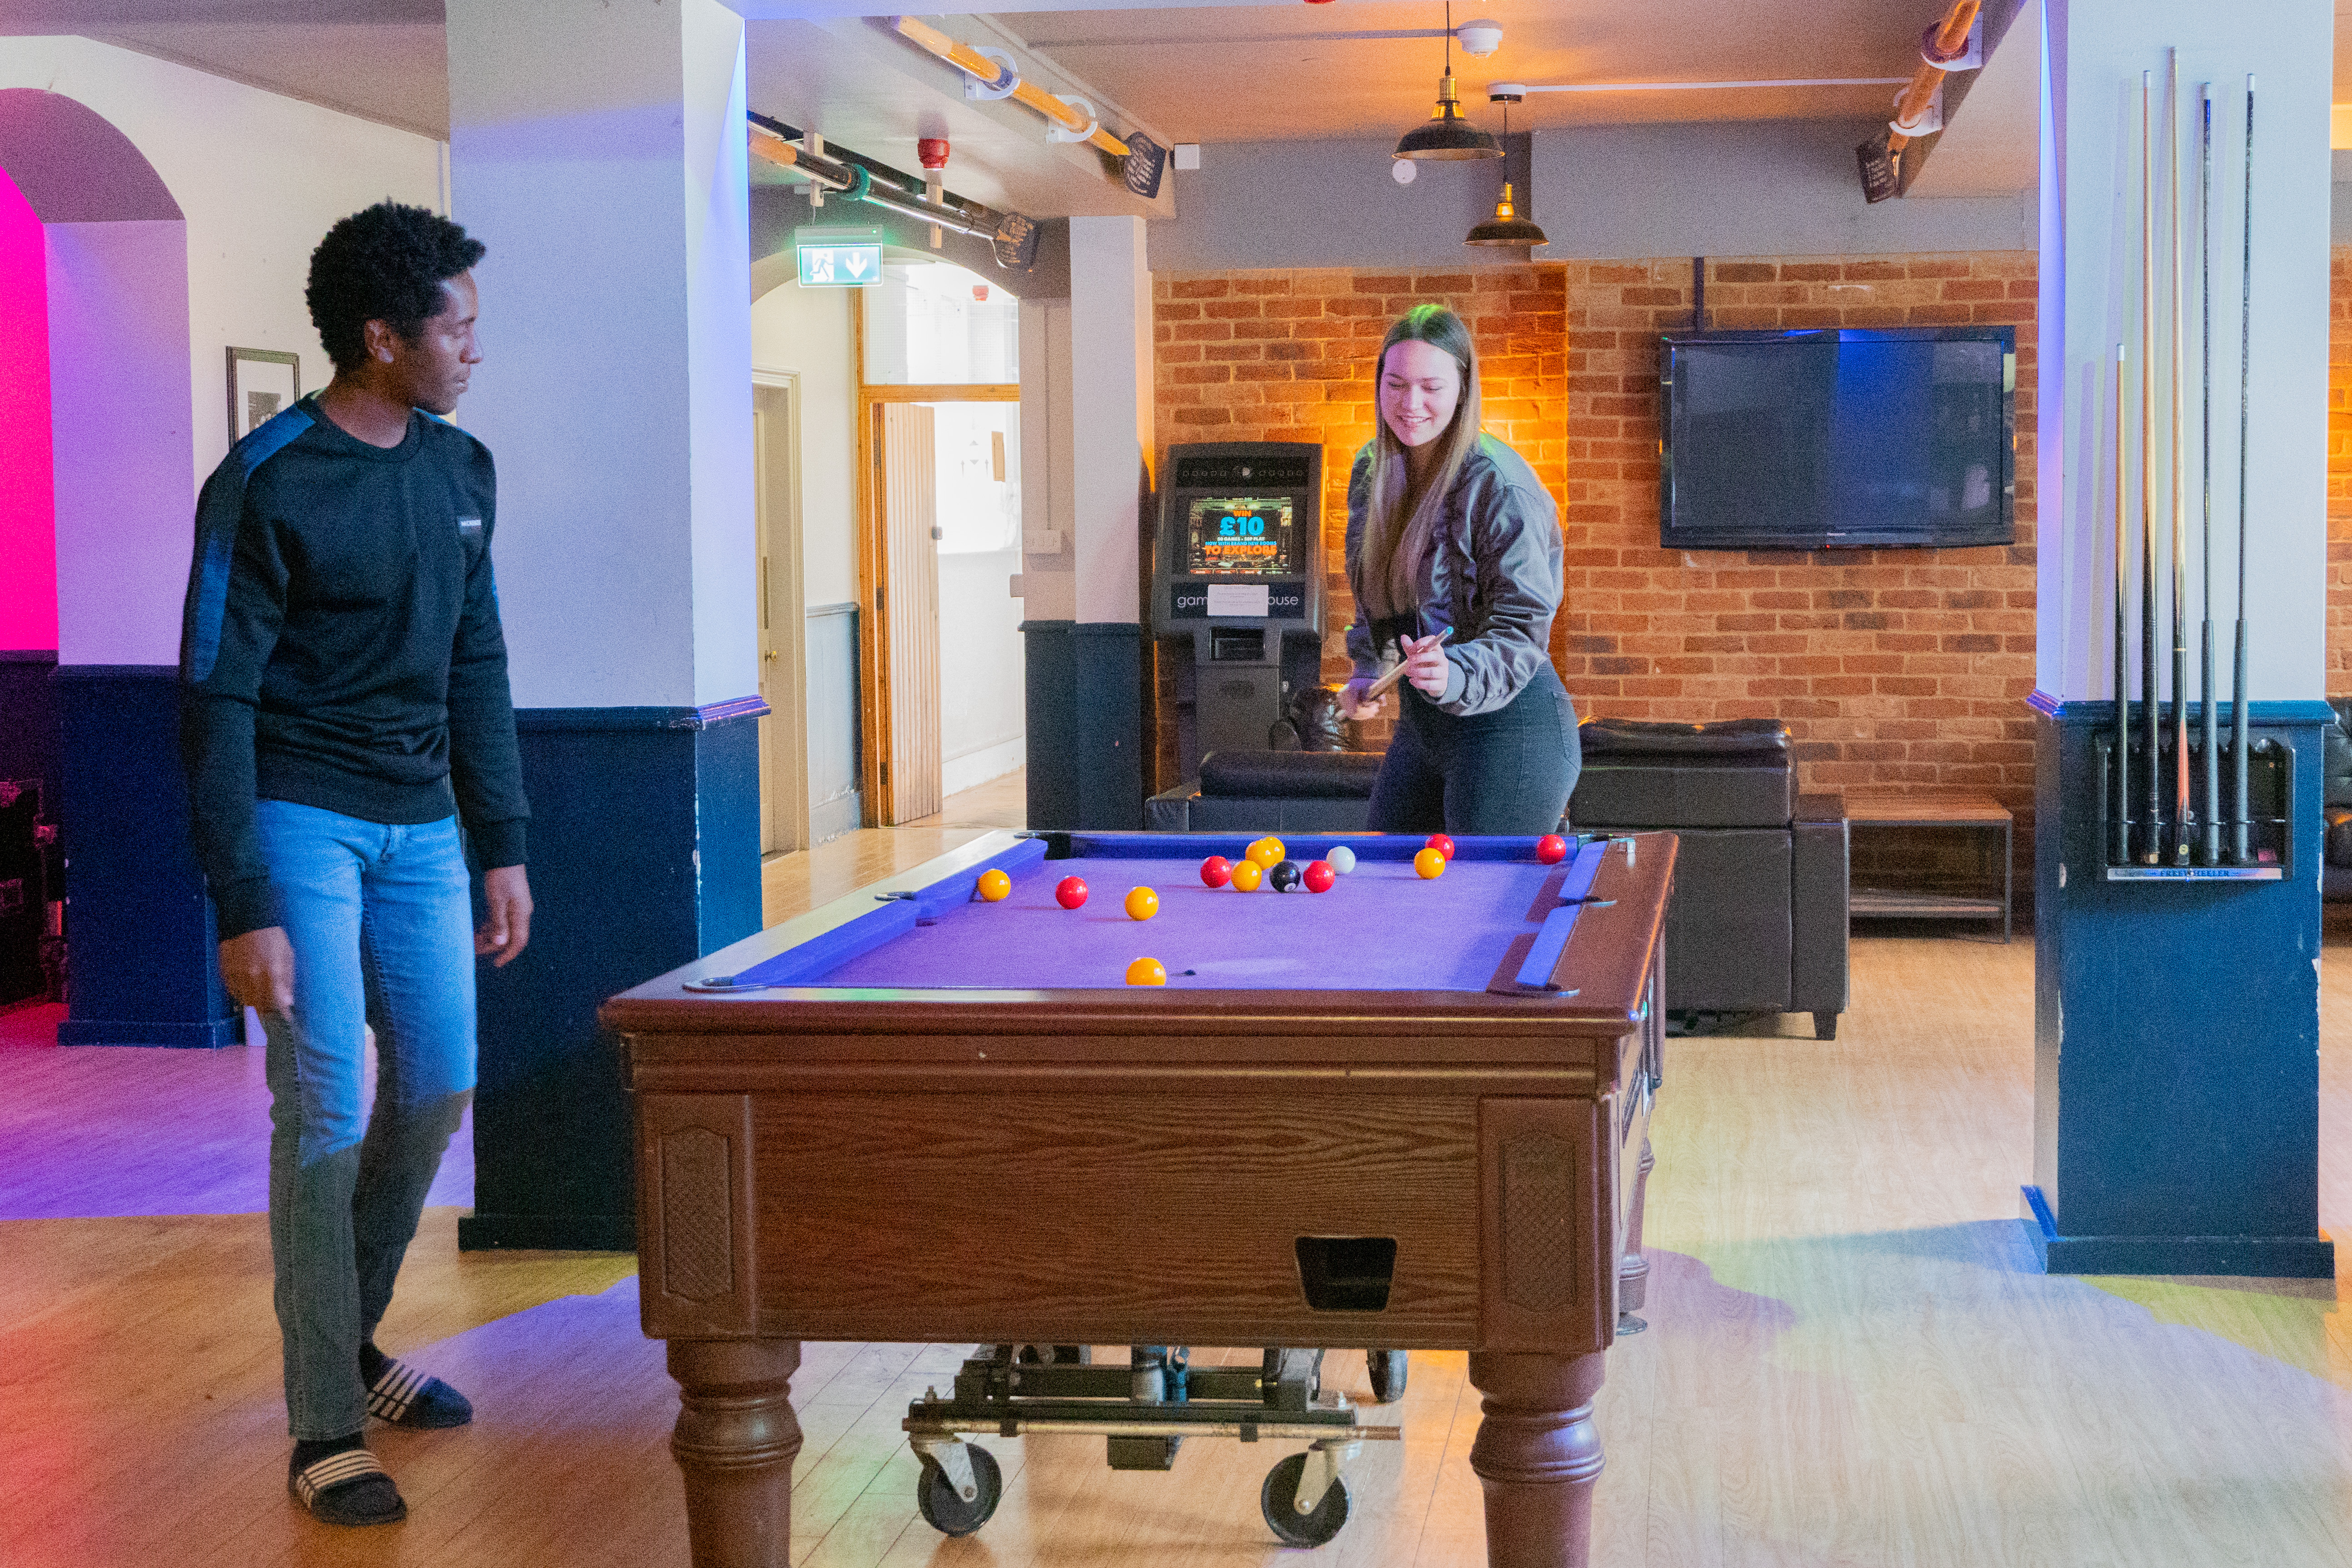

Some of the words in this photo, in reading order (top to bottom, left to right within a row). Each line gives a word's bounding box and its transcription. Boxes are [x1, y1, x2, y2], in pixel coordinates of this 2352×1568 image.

[1219, 516, 1264, 536] £10
[1205, 545, 1221, 555] TO
[1223, 545, 1277, 555] EXPLORE
[1178, 596, 1208, 608] gam
[1268, 596, 1298, 605] ouse
